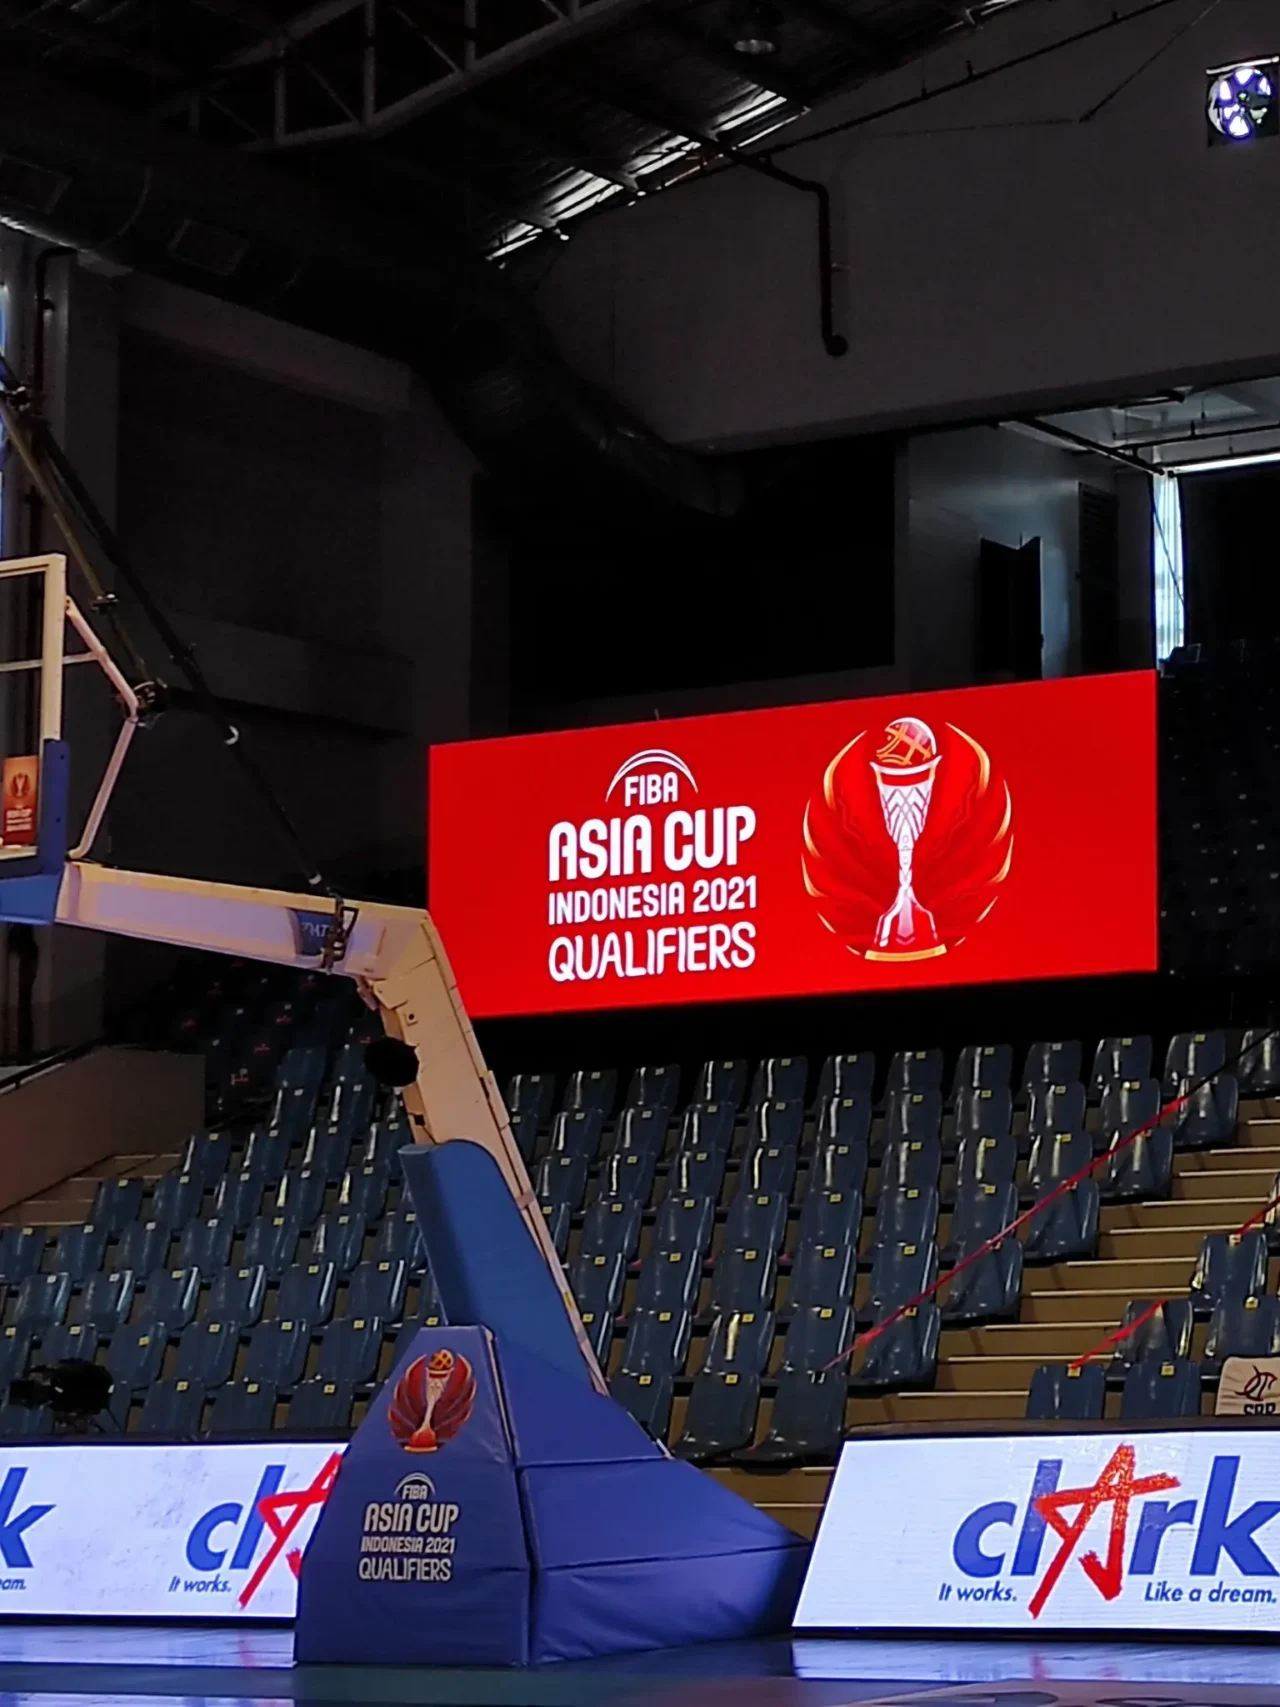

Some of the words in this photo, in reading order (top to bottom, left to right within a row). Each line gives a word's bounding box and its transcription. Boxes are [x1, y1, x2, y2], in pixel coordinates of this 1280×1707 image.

[625, 772, 678, 806] FIBA
[549, 814, 652, 882] ASIA
[664, 806, 756, 871] CUP
[549, 882, 684, 925] INDONESIA
[693, 876, 756, 913] 2021
[548, 921, 756, 982] QUALIFIERS
[402, 1485, 428, 1500] FIBA
[364, 1503, 413, 1532] ASIA
[416, 1504, 459, 1532] CUP
[361, 1536, 423, 1552] INDONESIA
[425, 1537, 456, 1554] 2021
[358, 1557, 452, 1581] QUALIFIERS
[168, 1576, 180, 1592] It
[184, 1577, 232, 1592] works.
[938, 1583, 953, 1601] It
[956, 1581, 1018, 1602] works.
[1145, 1582, 1182, 1602] Like
[1189, 1586, 1202, 1602] a
[1208, 1580, 1277, 1604] dream.
